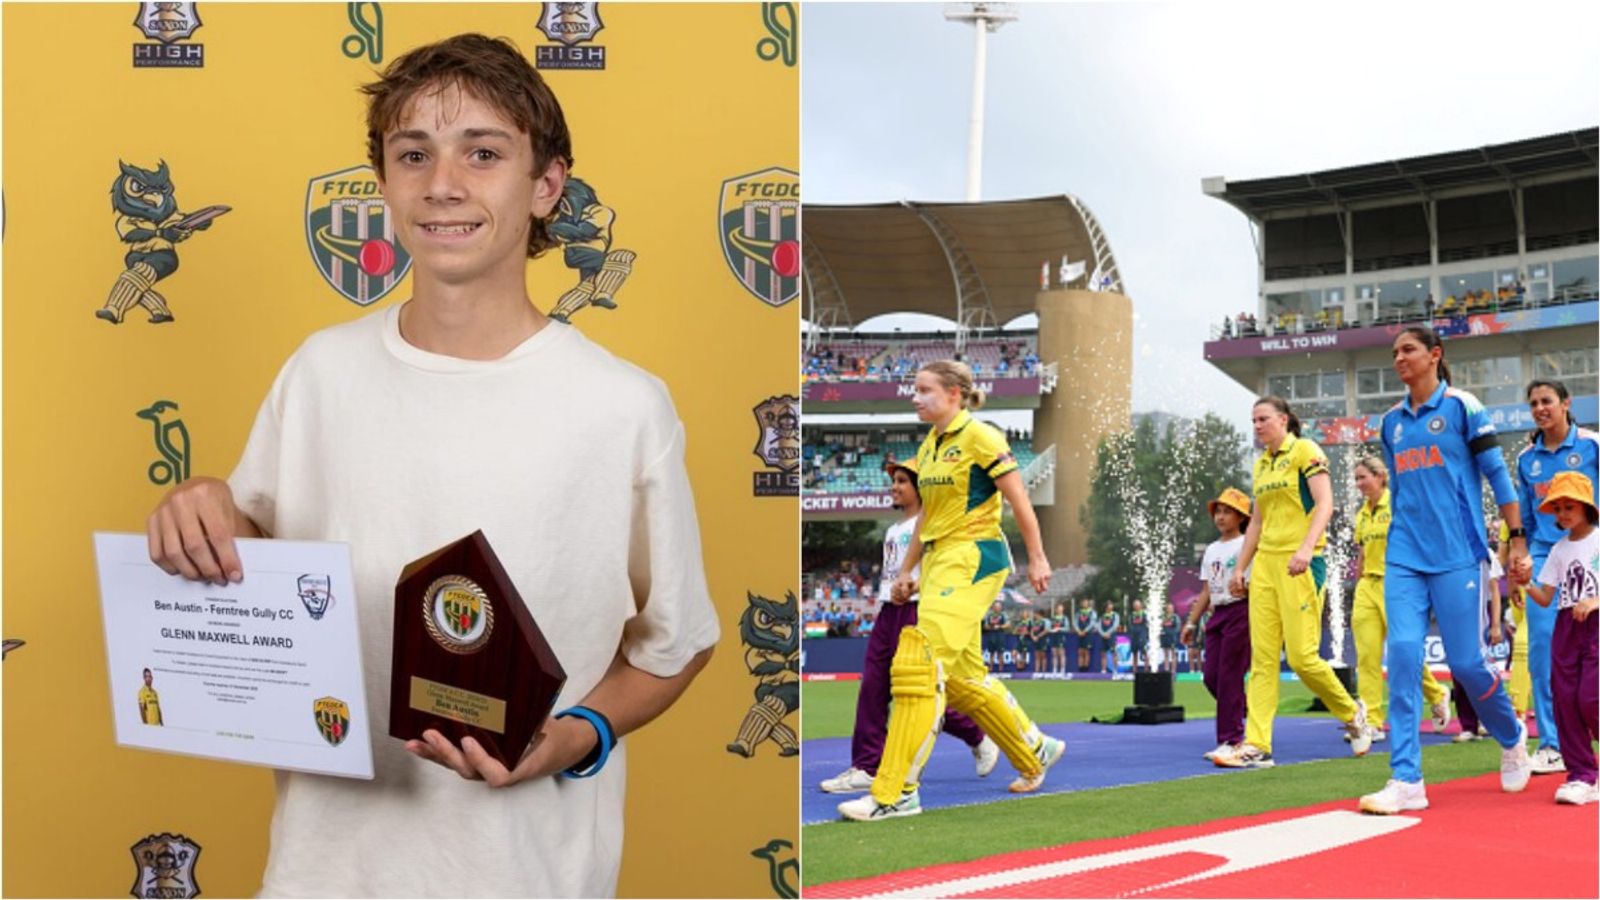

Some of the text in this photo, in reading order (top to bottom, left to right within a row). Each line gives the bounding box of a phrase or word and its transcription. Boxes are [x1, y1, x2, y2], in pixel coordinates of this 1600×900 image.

[149, 20, 187, 30] SAXON
[551, 22, 590, 33] SAXON
[136, 45, 201, 58] HIGH
[538, 48, 603, 60] HIGH
[323, 181, 383, 195] FTGD
[1261, 334, 1338, 351] WILL TO WIN
[1395, 445, 1444, 474] NDIA
[842, 495, 893, 508] WORLD
[155, 600, 172, 611] Ben
[174, 602, 203, 613] Austin
[210, 604, 250, 617] Ferntree
[252, 607, 277, 620] Gully
[279, 609, 294, 620] CC
[161, 627, 293, 649] GLENN MAXWELL AWARD
[436, 699, 479, 716] Ben Austin
